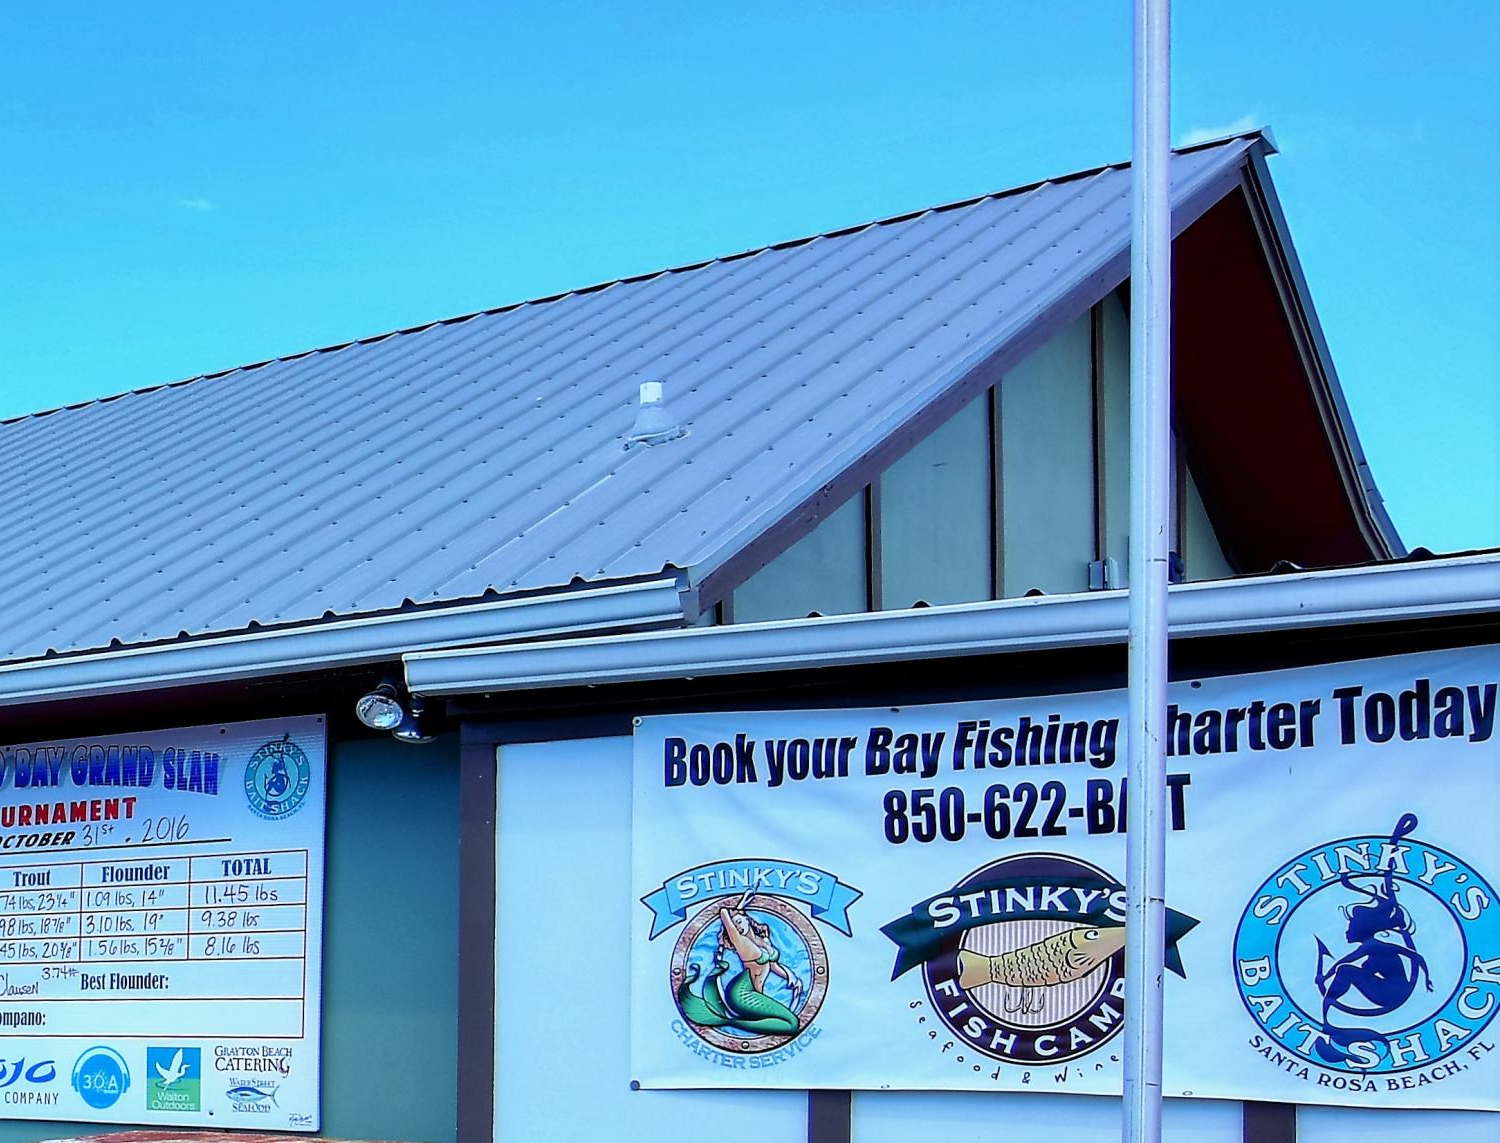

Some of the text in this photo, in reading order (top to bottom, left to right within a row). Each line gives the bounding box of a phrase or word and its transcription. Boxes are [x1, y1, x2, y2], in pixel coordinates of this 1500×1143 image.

[664, 678, 1498, 788] Book your Bay Fishing harter Today
[15, 747, 65, 788] BAY
[71, 744, 155, 788] GRAND
[162, 747, 222, 795] SLAM
[883, 773, 1191, 844] 850-622-BT
[82, 824, 114, 846] 31st
[142, 814, 190, 843] 2016
[13, 869, 51, 887] Trout
[102, 864, 170, 883] Flounder
[221, 858, 271, 876] TOTAL
[676, 867, 823, 900] STINKY'S
[1253, 843, 1490, 926] STINKY'S
[205, 886, 249, 903] 11.45
[255, 886, 279, 901] lbs
[928, 885, 1126, 928] STINKY'S
[201, 911, 237, 927] 9.38
[243, 911, 260, 927] lbs
[205, 939, 236, 956] 8.16
[243, 939, 260, 955] lbs
[81, 973, 169, 991] Best Flounder:
[935, 979, 1016, 1053] FISH
[1239, 955, 1500, 1069] BAIT SHACK
[670, 1019, 823, 1069] CHARTER SERVICE
[910, 1001, 1119, 1083] Seafood & Wine
[215, 1057, 290, 1079] CATERING
[1249, 1035, 1495, 1092] SANTA ROSA BEACH, FL
[4, 1092, 59, 1105] COMPANY
[151, 1101, 195, 1110] Outdoors
[157, 1092, 190, 1101] Walton
